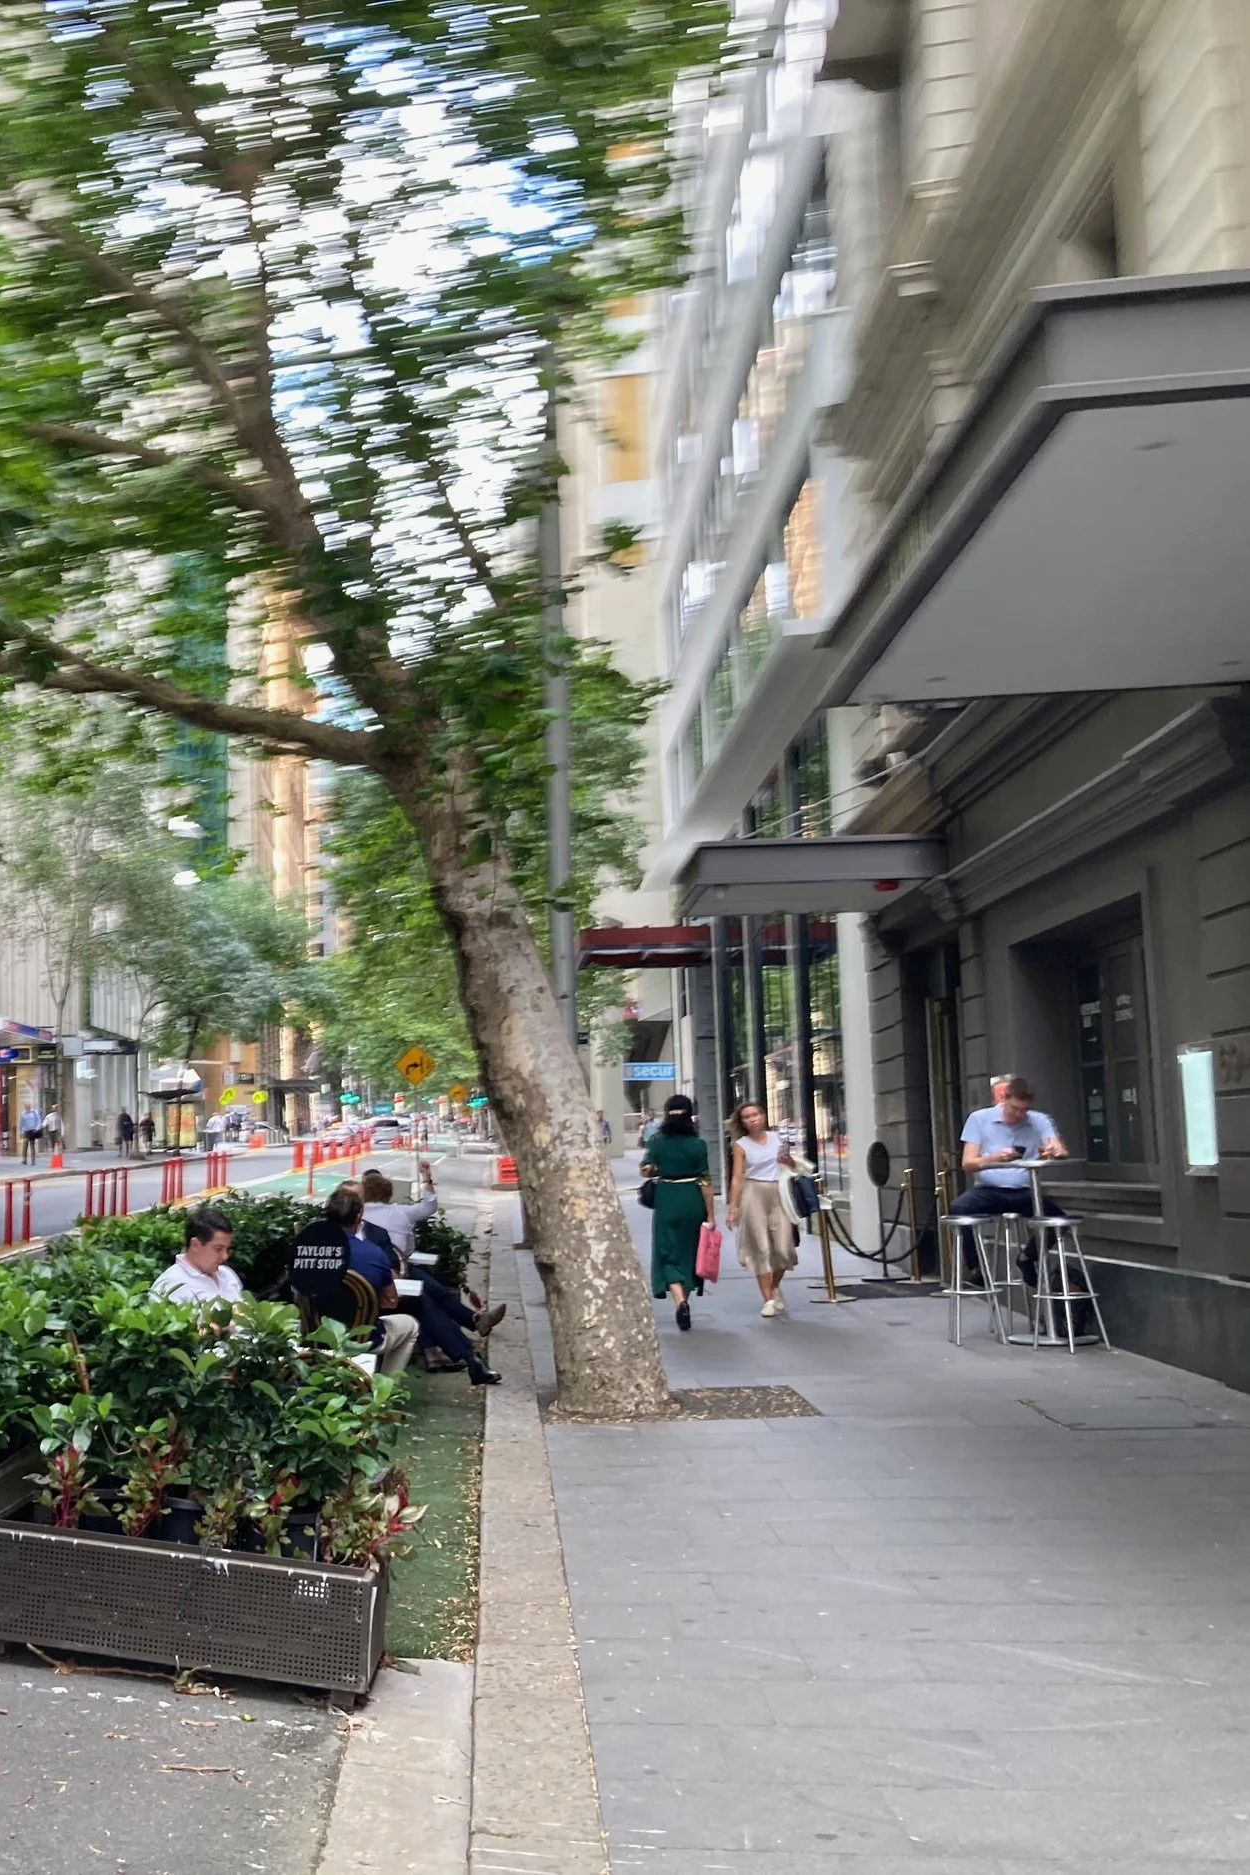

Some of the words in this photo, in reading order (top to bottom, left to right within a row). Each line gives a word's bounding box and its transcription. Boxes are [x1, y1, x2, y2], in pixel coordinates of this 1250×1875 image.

[297, 1245, 343, 1257] TAYLOR'S
[293, 1258, 317, 1269] PITT
[317, 1258, 343, 1270] STOP
